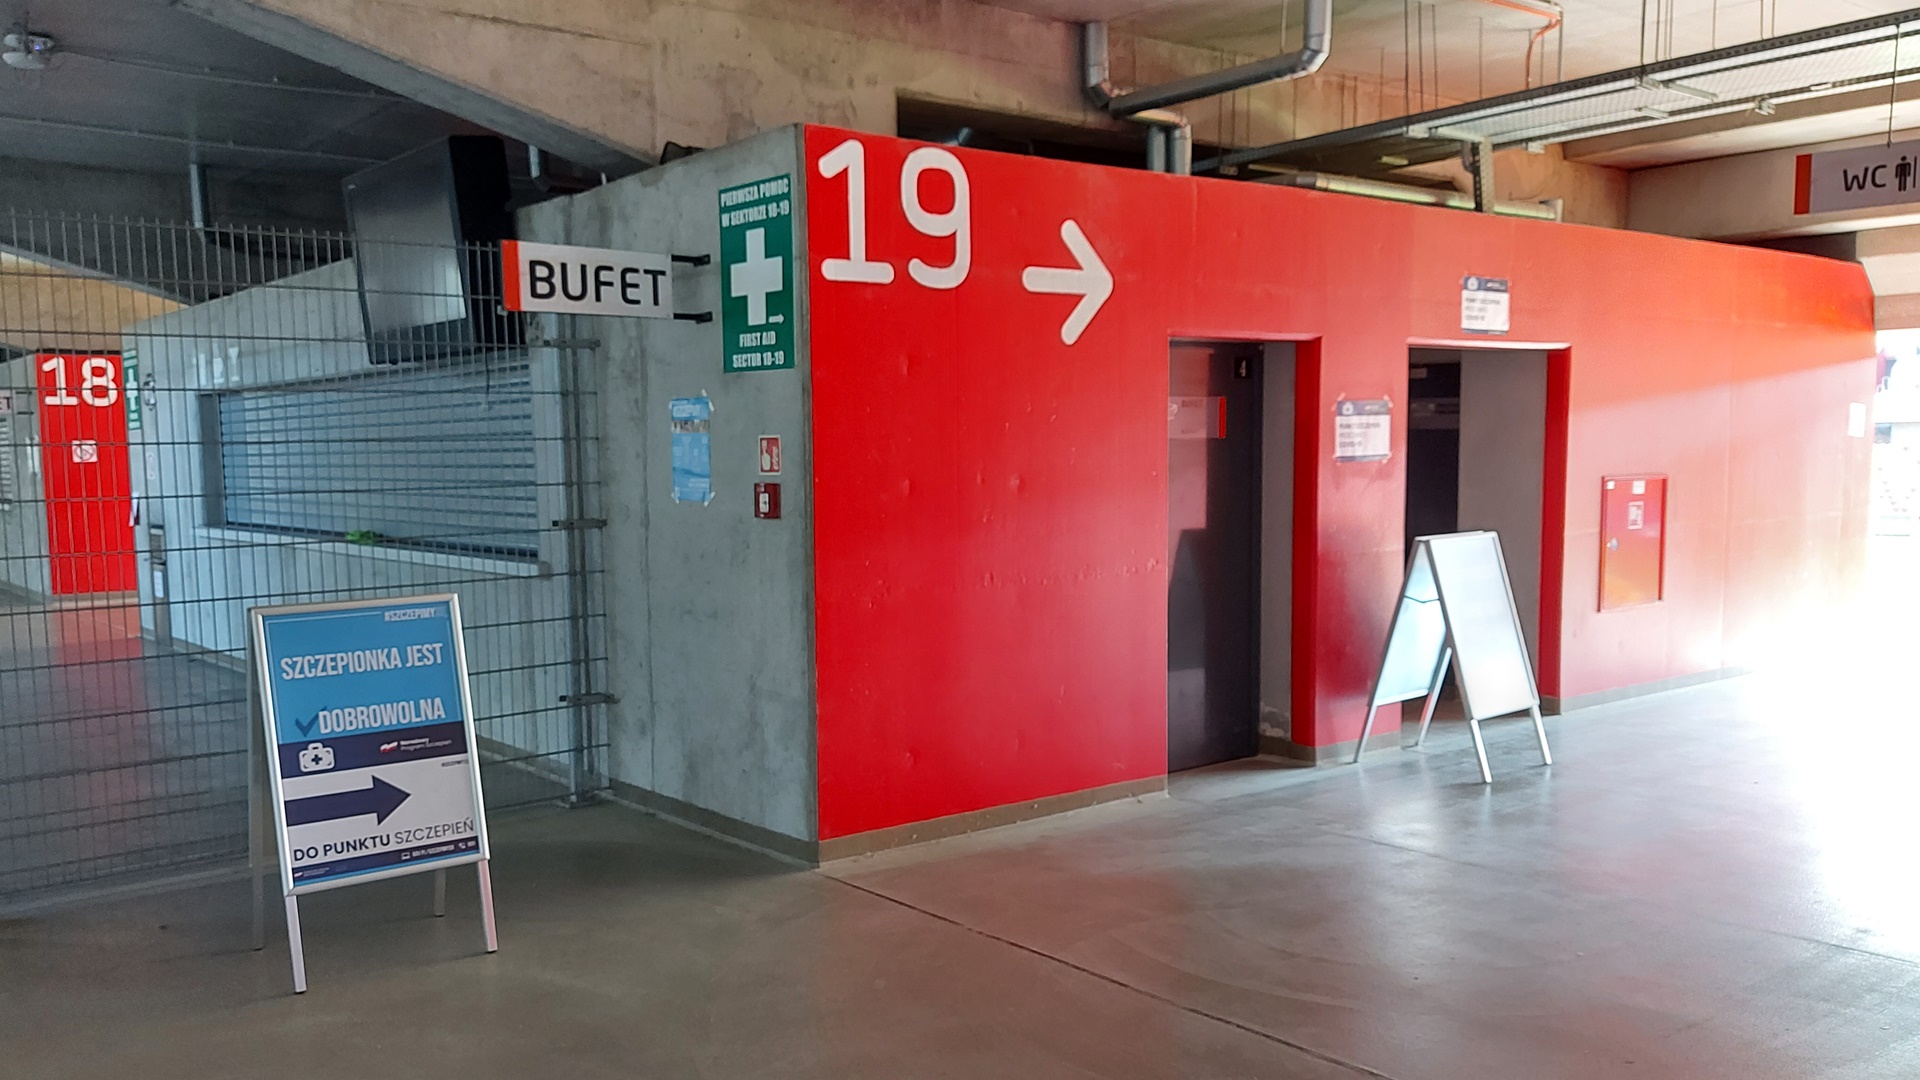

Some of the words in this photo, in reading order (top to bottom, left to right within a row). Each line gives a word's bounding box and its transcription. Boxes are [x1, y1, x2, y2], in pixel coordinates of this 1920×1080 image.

[720, 184, 760, 208] PIERWSZA
[759, 177, 789, 199] POMOC
[1842, 162, 1888, 194] WC
[721, 212, 731, 228] W
[731, 205, 767, 227] SEKTORZE
[767, 199, 790, 219] 18-19
[817, 138, 972, 290] 19
[527, 259, 667, 307] BUFET
[739, 332, 762, 348] FIRST
[762, 330, 777, 346] AID
[732, 352, 762, 369] SECTOR
[762, 350, 785, 367] 18-19
[41, 356, 118, 407] 18
[280, 645, 400, 681] SZCZEPIONKA
[405, 642, 444, 667] JEST
[318, 697, 446, 735] DOBROWOLNA
[294, 846, 319, 862] DO
[323, 833, 391, 857] PUNKTU
[394, 817, 475, 845] SZCZEPIEŃ
